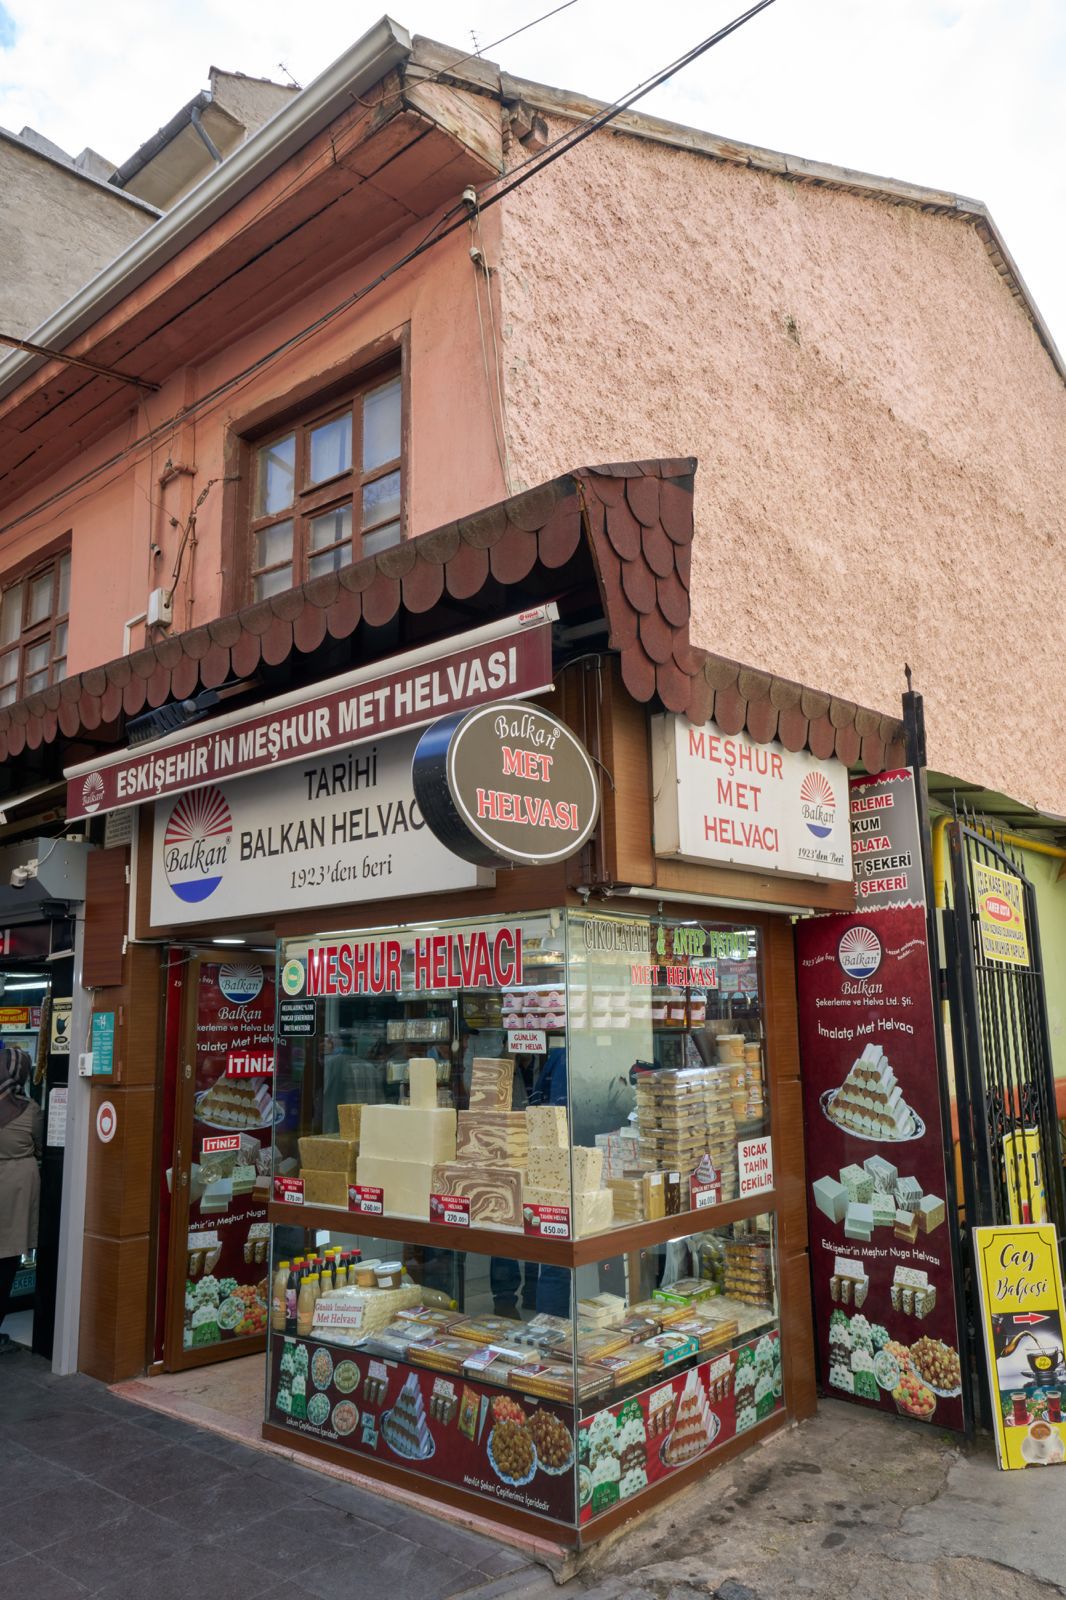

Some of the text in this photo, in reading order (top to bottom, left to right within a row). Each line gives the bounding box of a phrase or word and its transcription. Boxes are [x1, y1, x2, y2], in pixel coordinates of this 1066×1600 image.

[117, 646, 517, 798] ESKİŞEHİR'İN MEŞHUR MET HELVASI
[502, 746, 553, 782] MET
[688, 729, 784, 780] MEŞHUR
[304, 747, 377, 801] TARİHİ
[716, 777, 762, 812] MET
[850, 794, 894, 813] RLEME
[476, 788, 580, 831] HELVASI
[240, 798, 427, 862] BALKAN HELVAC
[703, 815, 780, 852] HELVACI
[851, 817, 880, 833] KUM
[852, 836, 891, 853] OLATA
[290, 853, 393, 889] 1923'den beri
[866, 851, 912, 876] ŞEKERİ
[861, 873, 908, 897] ŞEKERİ
[656, 926, 666, 956] &
[672, 927, 706, 957] ANTEP
[306, 940, 402, 997] MEŞHUR
[414, 926, 523, 991] HELVACI
[842, 952, 878, 967] Balkan
[631, 963, 660, 986] MET
[666, 965, 718, 987] HELVASI
[221, 979, 259, 993] Balkan
[841, 979, 883, 997] Balkan
[815, 998, 851, 1008] Şekerleme
[863, 997, 884, 1006] Helva
[886, 997, 900, 1006] Ltd.
[901, 996, 914, 1008] Şti.
[218, 1005, 262, 1022] Balkan
[196, 1023, 228, 1032] kerleme
[240, 1023, 262, 1032] Helva
[513, 1032, 538, 1041] GÜNLÜK
[817, 1018, 914, 1041] İmalatçı Met Helvacı
[231, 1036, 251, 1048] Met
[525, 1043, 543, 1051] HELVA
[206, 1138, 238, 1150] İTİNİZ
[742, 1142, 768, 1159] SICAK
[743, 1158, 768, 1174] TAHİN
[741, 1172, 773, 1194] ÇEKİLİR
[216, 1214, 245, 1227] Meşhur
[246, 1209, 267, 1218] Nuga
[821, 1238, 940, 1266] Eskişehir'in Meşhur Nuga Helvası
[316, 1312, 357, 1325] Met Helvası
